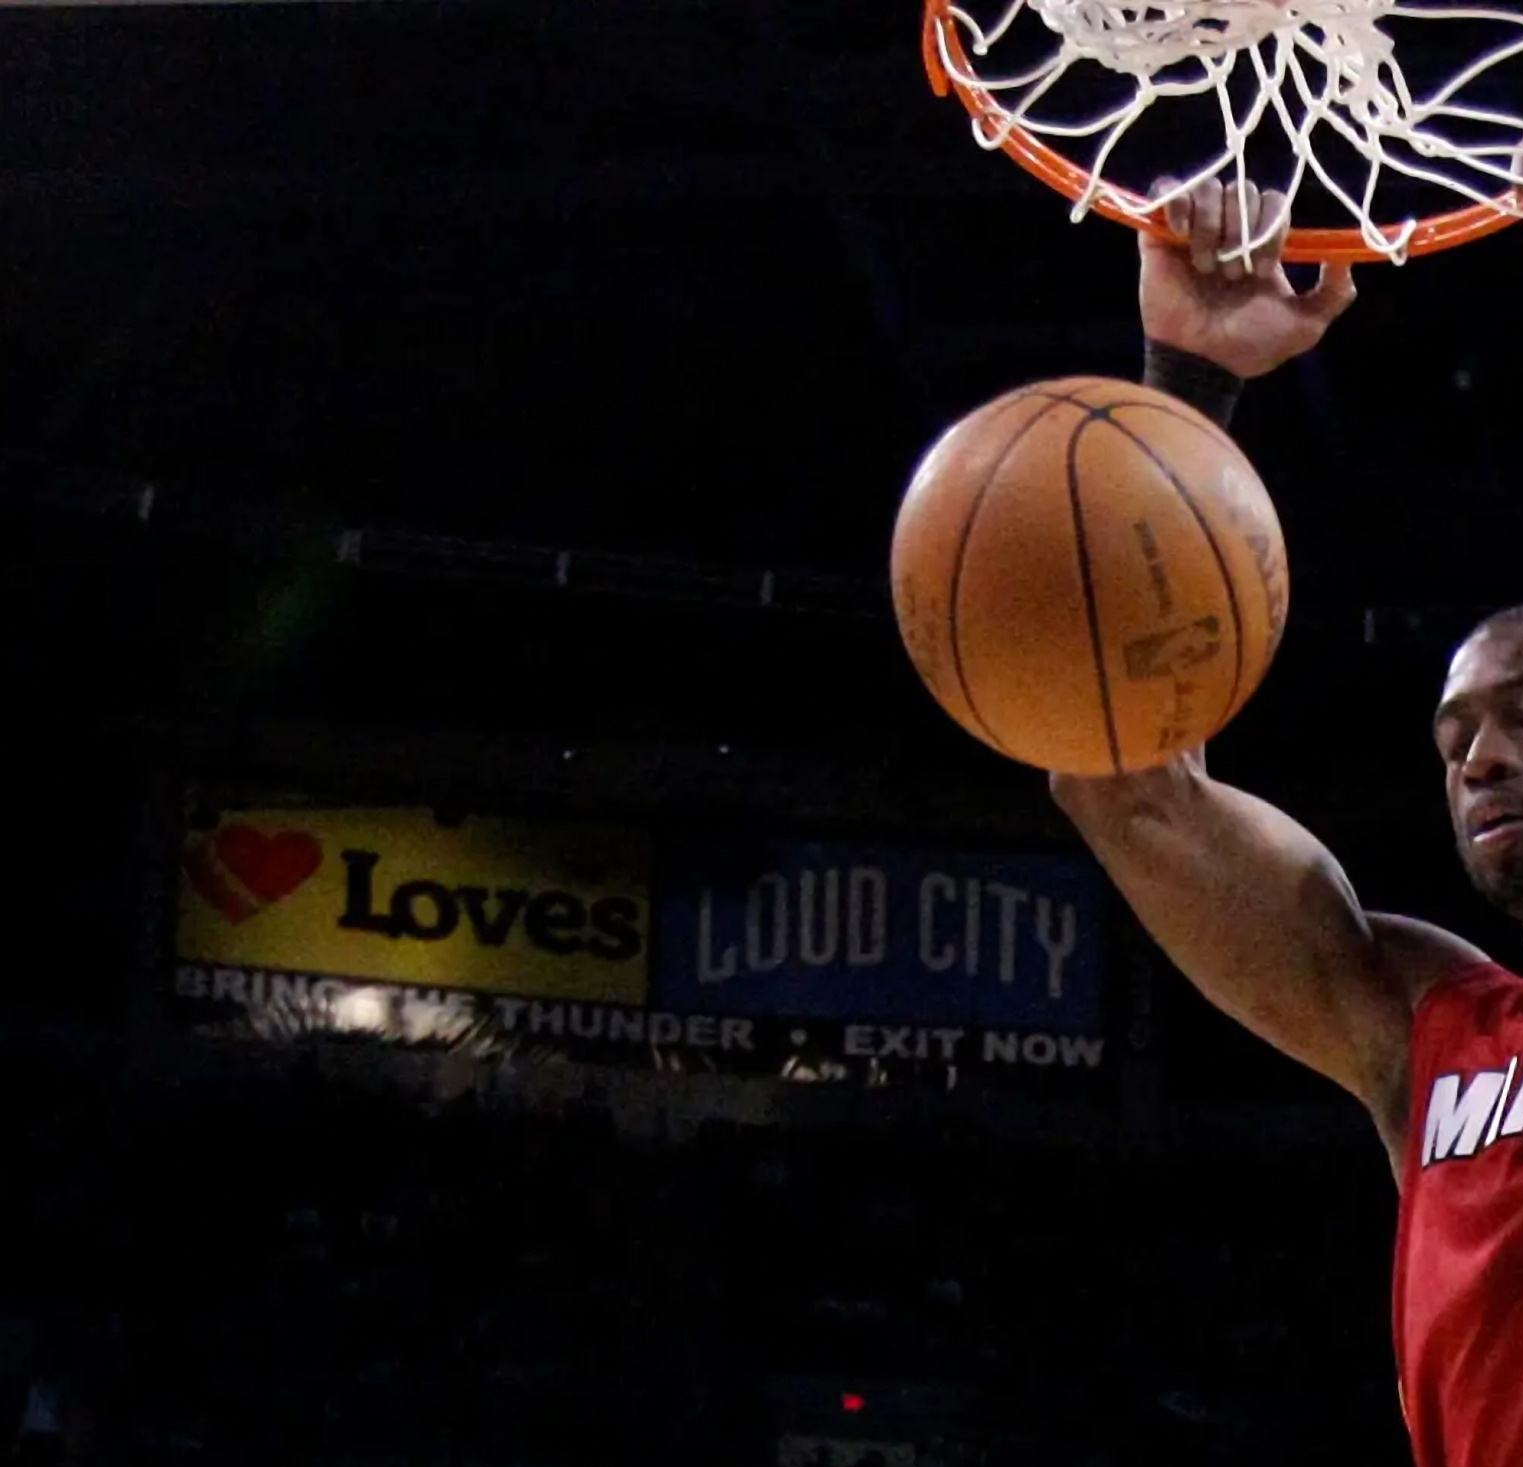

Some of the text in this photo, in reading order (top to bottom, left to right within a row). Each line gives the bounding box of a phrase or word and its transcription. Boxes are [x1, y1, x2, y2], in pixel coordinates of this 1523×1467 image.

[337, 848, 643, 961] Loves
[696, 865, 1078, 999] LOUD CITY
[501, 998, 755, 1052] THUNDER
[843, 1023, 964, 1058] EXIT
[982, 1029, 1104, 1067] NOW
